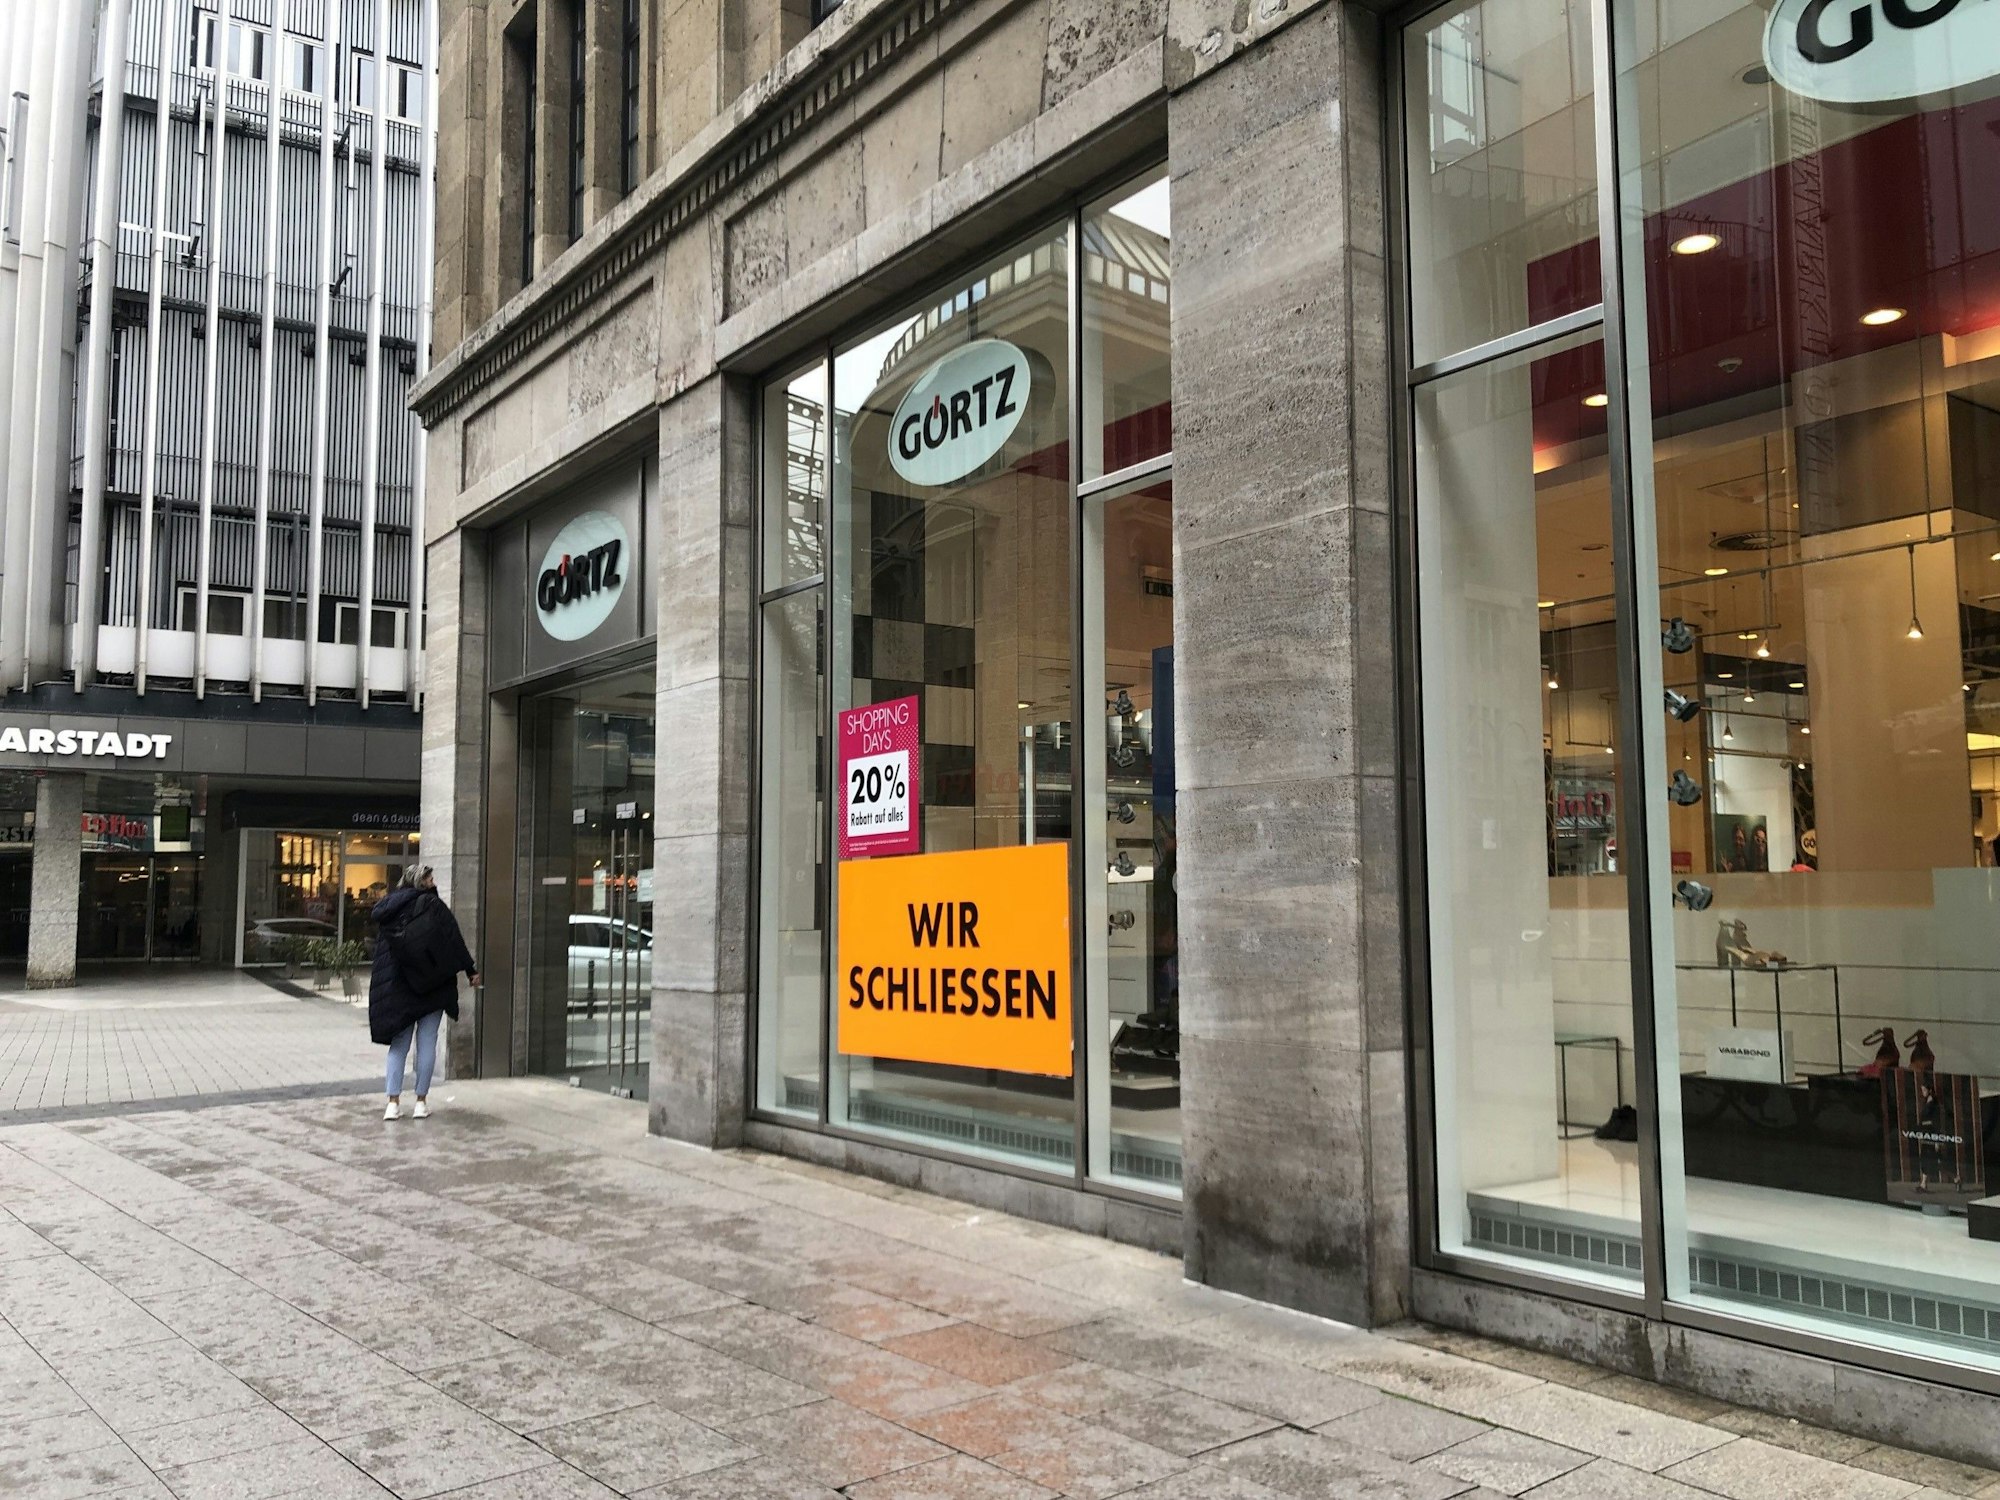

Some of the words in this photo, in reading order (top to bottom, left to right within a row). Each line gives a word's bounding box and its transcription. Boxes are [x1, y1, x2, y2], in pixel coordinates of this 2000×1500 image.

[847, 703, 909, 735] SHOPPING
[0, 727, 172, 759] ARSTADT
[863, 729, 892, 754] DAYS
[851, 763, 906, 804] 20%
[352, 812, 380, 823] dean
[850, 811, 873, 827] Rabatt
[875, 808, 886, 823] auf
[908, 902, 980, 948] WIR
[849, 965, 1057, 1020] SCHLIESSEN
[1718, 1046, 1771, 1058] VAGABOND
[1902, 1130, 1963, 1144] VAGABOND
